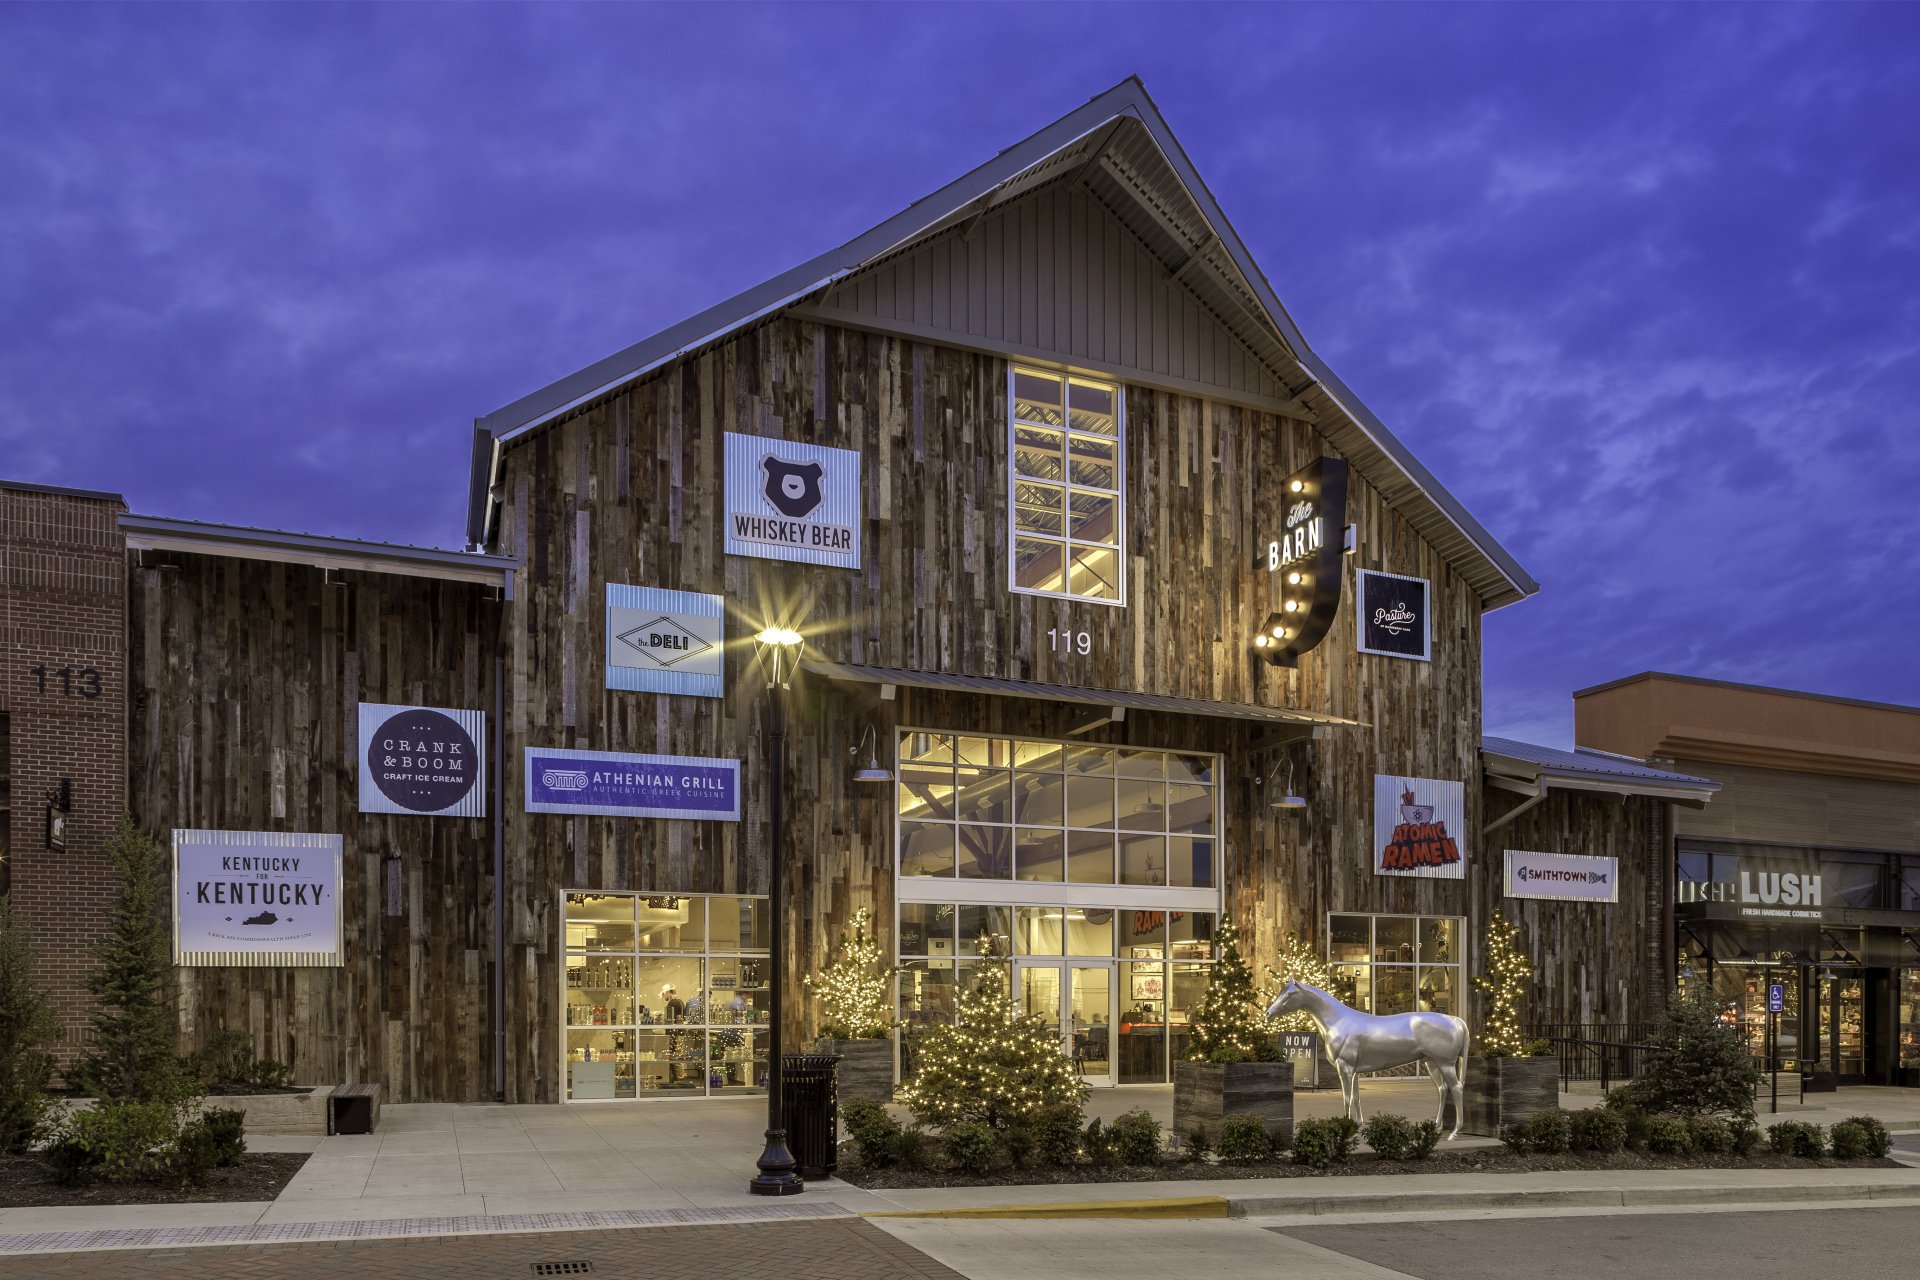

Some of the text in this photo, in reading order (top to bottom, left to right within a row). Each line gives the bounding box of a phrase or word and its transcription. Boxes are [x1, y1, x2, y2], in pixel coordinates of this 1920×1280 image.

[1287, 500, 1313, 528] The
[735, 515, 851, 549] WHISKEY BEAR
[1269, 516, 1322, 572] BARN
[1374, 602, 1416, 625] Pasture
[650, 633, 688, 650] DELI
[1047, 628, 1091, 655] 119
[30, 664, 101, 698] 113
[383, 739, 462, 754] CRANK
[383, 773, 463, 783] CRAFT ICE CREAM
[592, 771, 725, 790] ATHENIAN GRILL
[592, 785, 725, 799] AUTHENTIC GREEK CUISINE
[1392, 820, 1447, 842] ATOMIC
[222, 856, 300, 871] KENTUCKY
[1381, 837, 1461, 871] RAMEN
[1528, 869, 1587, 883] SMITHTOWN
[197, 881, 324, 905] KENTUCKY
[1741, 871, 1821, 906] LUSH
[1285, 1035, 1310, 1047] NOW
